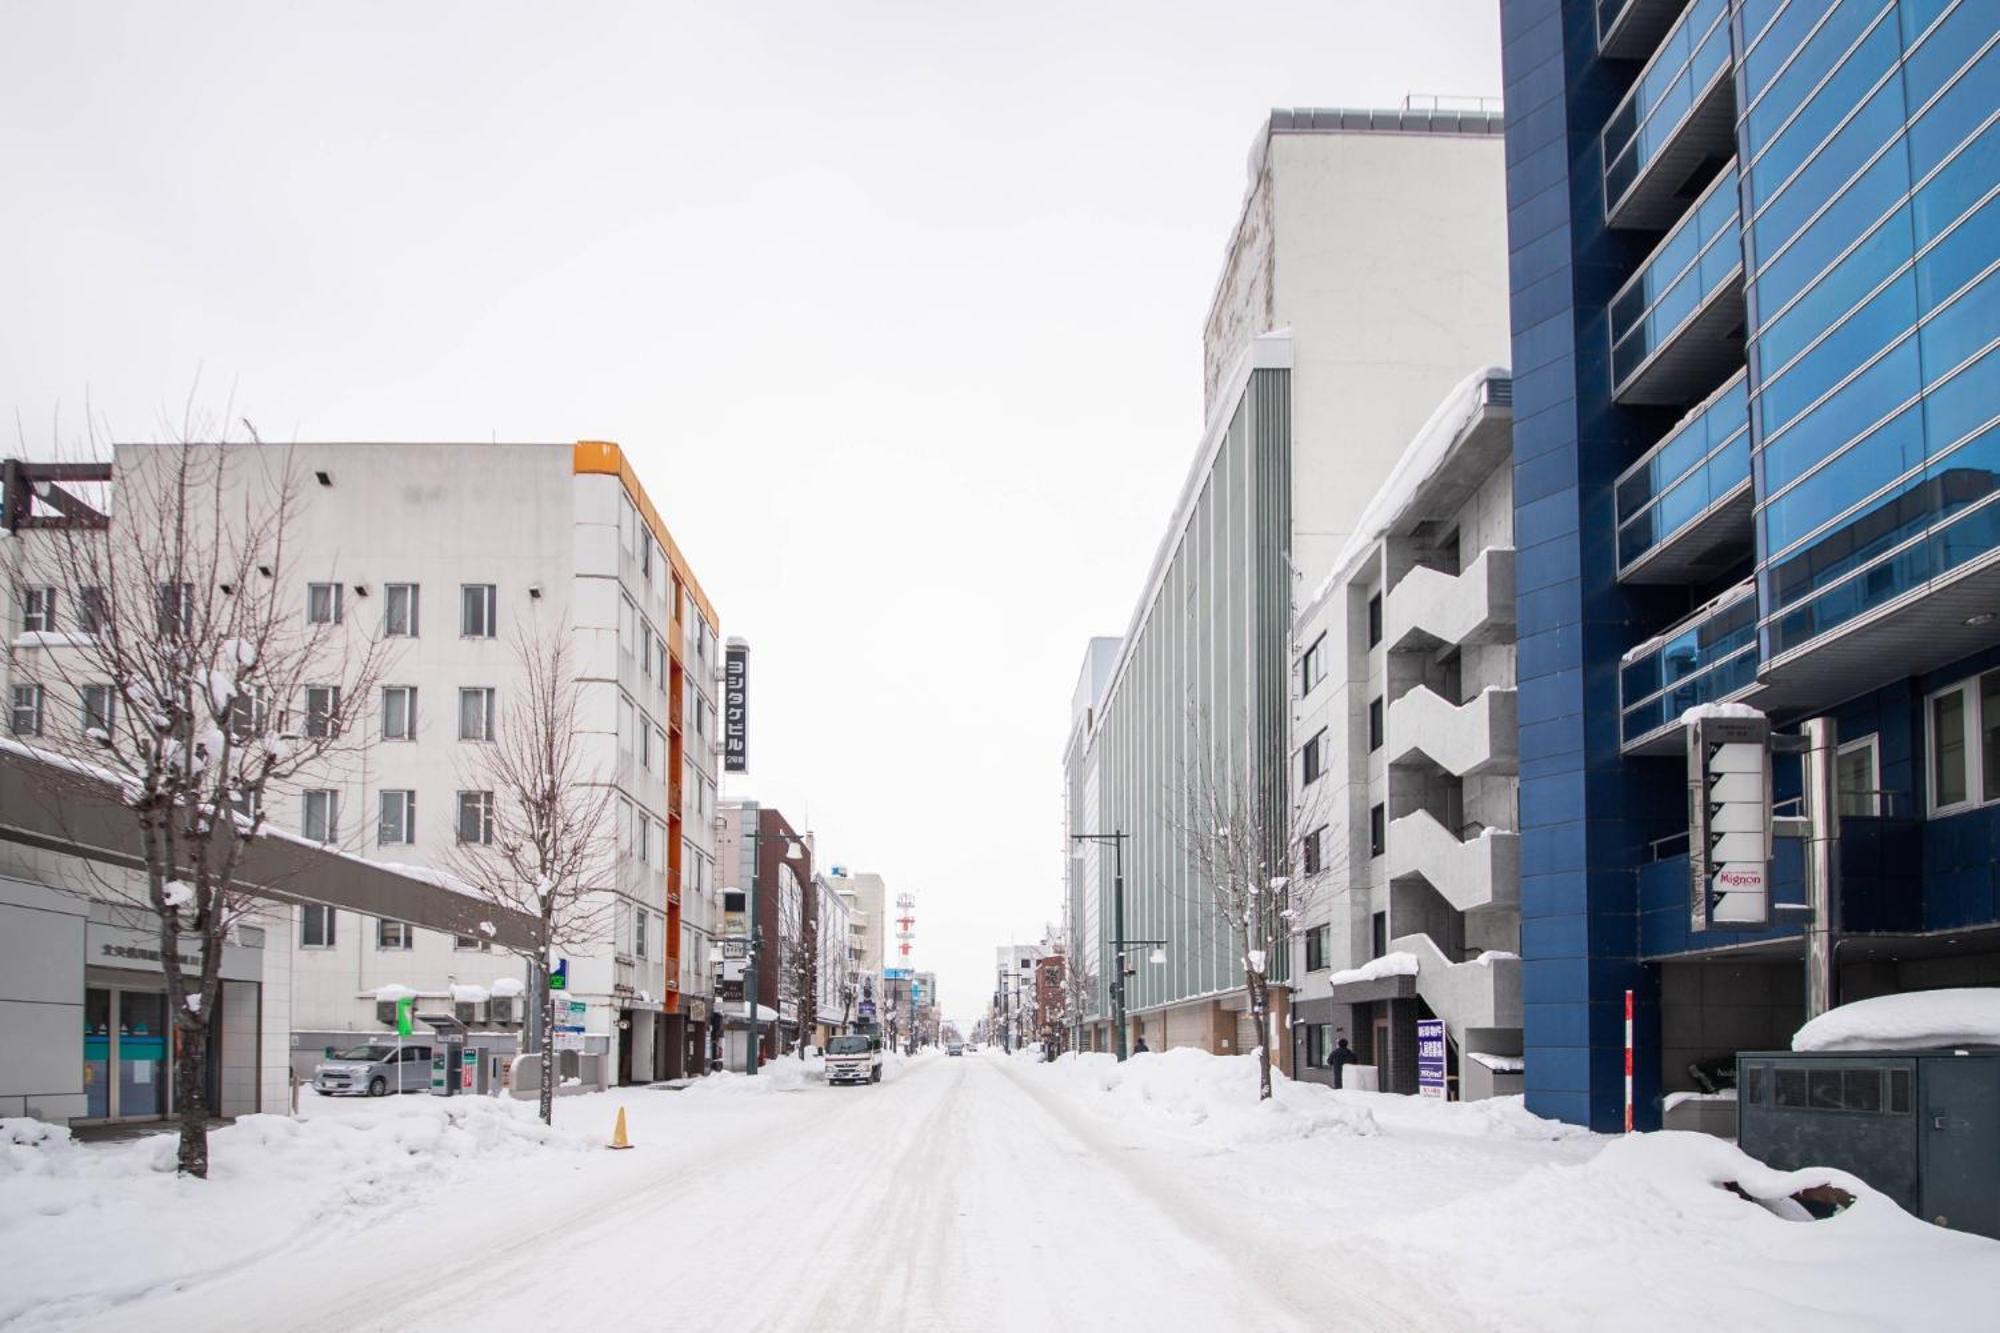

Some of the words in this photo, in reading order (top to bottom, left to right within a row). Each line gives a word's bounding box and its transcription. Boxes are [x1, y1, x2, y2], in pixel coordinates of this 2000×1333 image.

[727, 660, 744, 751] ヨシタケビル
[1720, 873, 1761, 887] Mignon
